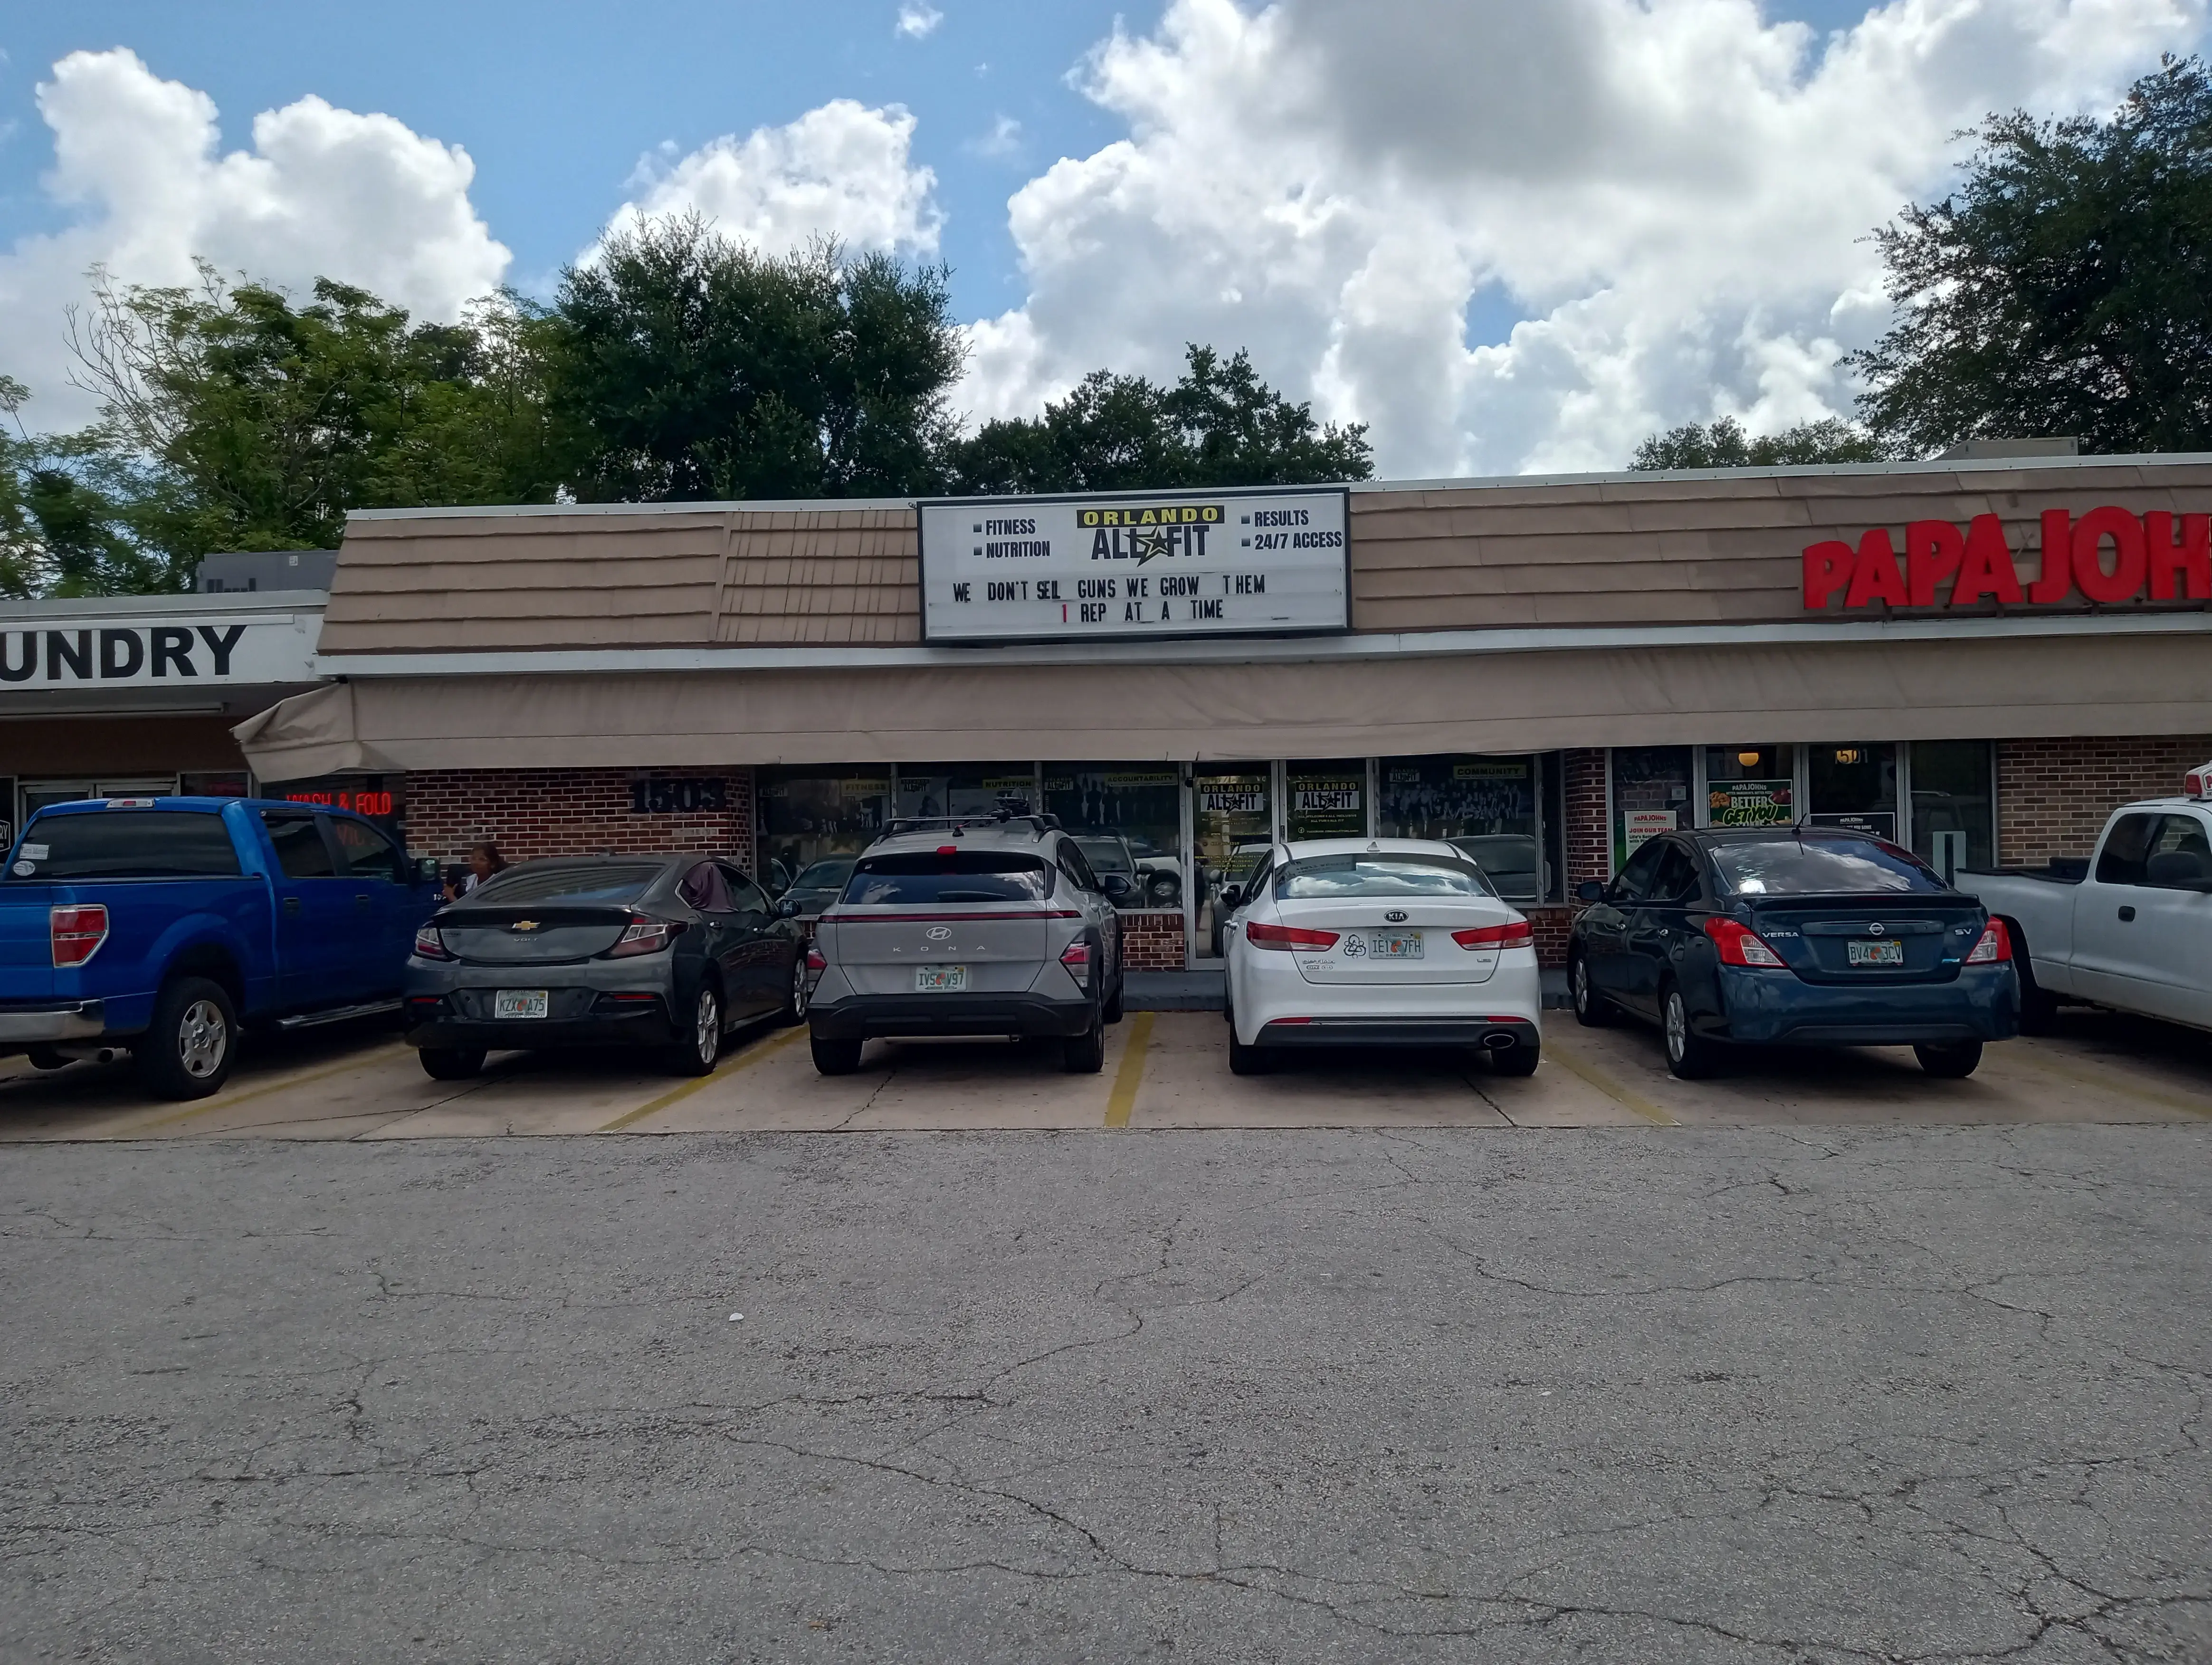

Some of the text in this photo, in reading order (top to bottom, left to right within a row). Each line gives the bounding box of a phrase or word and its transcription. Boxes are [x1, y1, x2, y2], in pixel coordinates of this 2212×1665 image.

[1084, 507, 1218, 526] ORLANDO
[1255, 509, 1309, 527] RESULTS
[986, 518, 1036, 536] FITNESS
[986, 540, 1050, 559] NUTRITION
[1091, 525, 1210, 560] ALL FIT
[1255, 531, 1343, 550] 24/7 ACCESS
[1802, 513, 2023, 610] PAPA
[953, 582, 971, 602] WE
[988, 581, 1028, 601] DON'T
[1078, 579, 1116, 599] GUNS
[1126, 578, 1148, 598] WE
[1160, 576, 1200, 596] GROW
[1223, 574, 1265, 594] THEM
[1062, 599, 1223, 623] 1 REP AT A TIME
[0, 624, 248, 682] UNDRY
[1835, 748, 1869, 765] 1501
[1458, 767, 1519, 775] COMMUNITY
[635, 778, 727, 813] 1503
[1203, 785, 1260, 793] ORLANDO
[1298, 782, 1357, 791] ORLANDO
[356, 792, 392, 815] FOLD
[1207, 794, 1257, 810] ALL FIT
[1302, 792, 1353, 808] ALL FIT
[1731, 796, 1768, 808] BETTER
[1724, 805, 1777, 825] GET YOU
[1373, 940, 1421, 953] IE1 7FH
[947, 973, 963, 985] V97
[500, 998, 544, 1012] KZX A75
